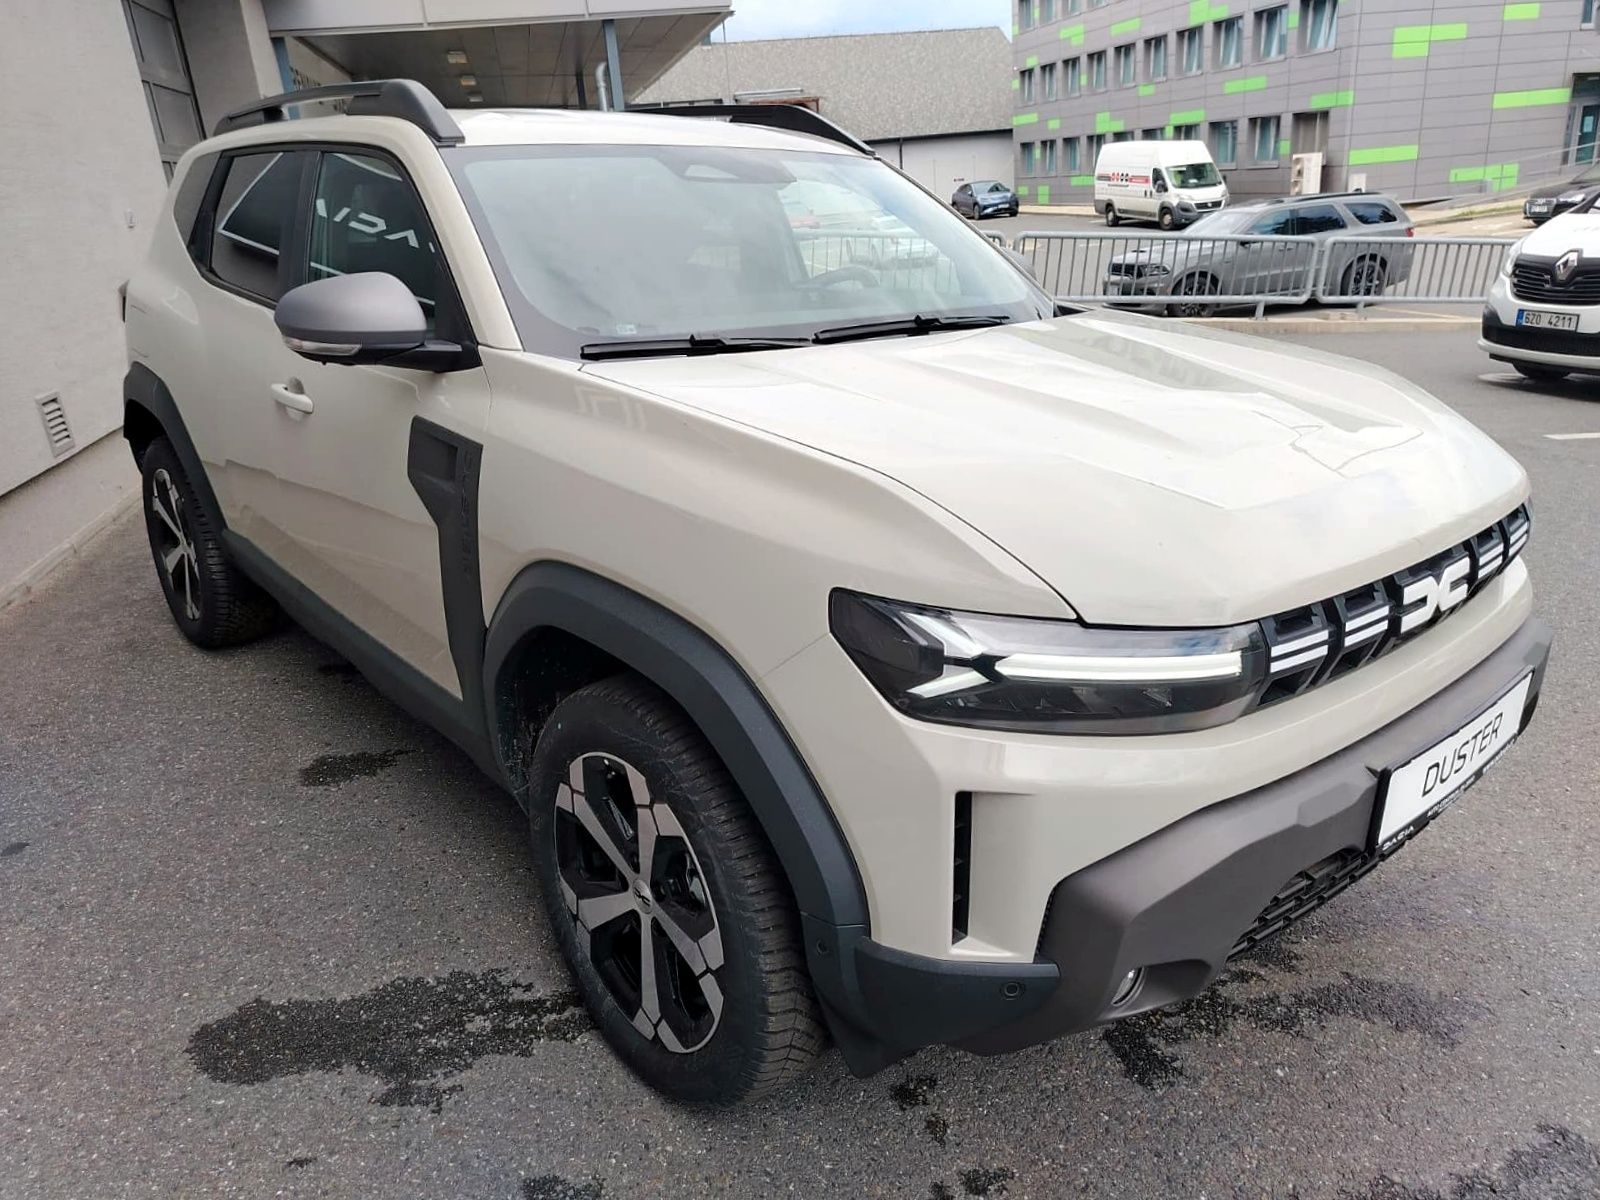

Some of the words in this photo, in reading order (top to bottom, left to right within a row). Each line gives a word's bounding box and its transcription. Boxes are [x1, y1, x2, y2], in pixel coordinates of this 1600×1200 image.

[1547, 315, 1573, 328] 4211
[1422, 713, 1503, 797] DUSTER
[1382, 826, 1415, 850] DACIA
